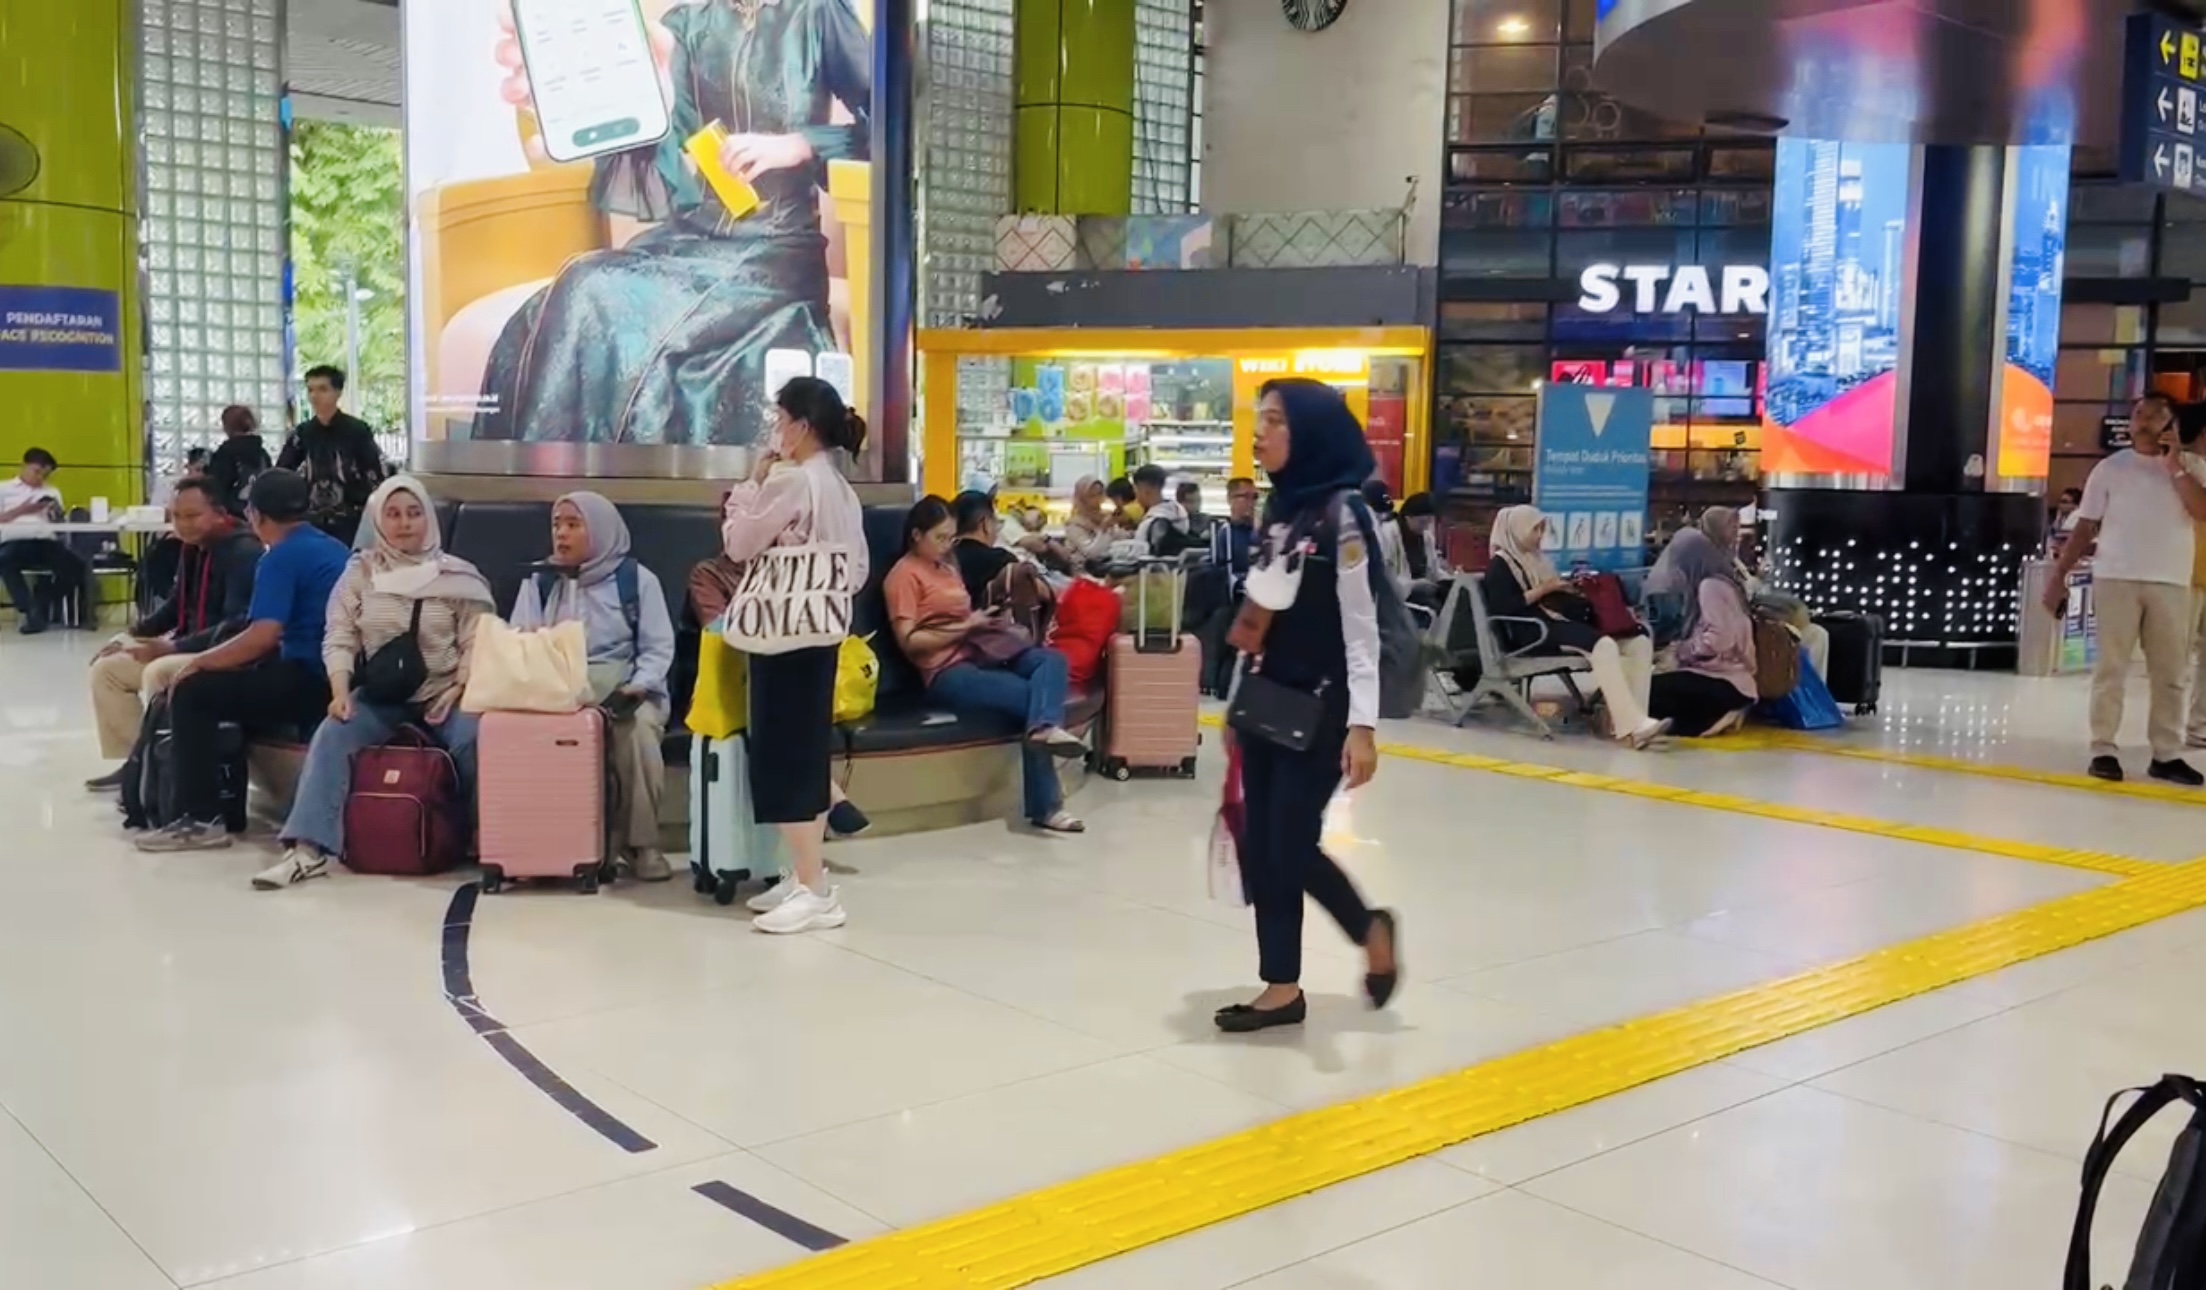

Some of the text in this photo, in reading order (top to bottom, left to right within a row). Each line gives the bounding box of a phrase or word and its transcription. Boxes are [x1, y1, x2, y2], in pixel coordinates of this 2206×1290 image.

[1578, 263, 1769, 313] STAR
[6, 311, 103, 327] PENDAFTARAN
[0, 329, 114, 344] ACE RECOGNITION
